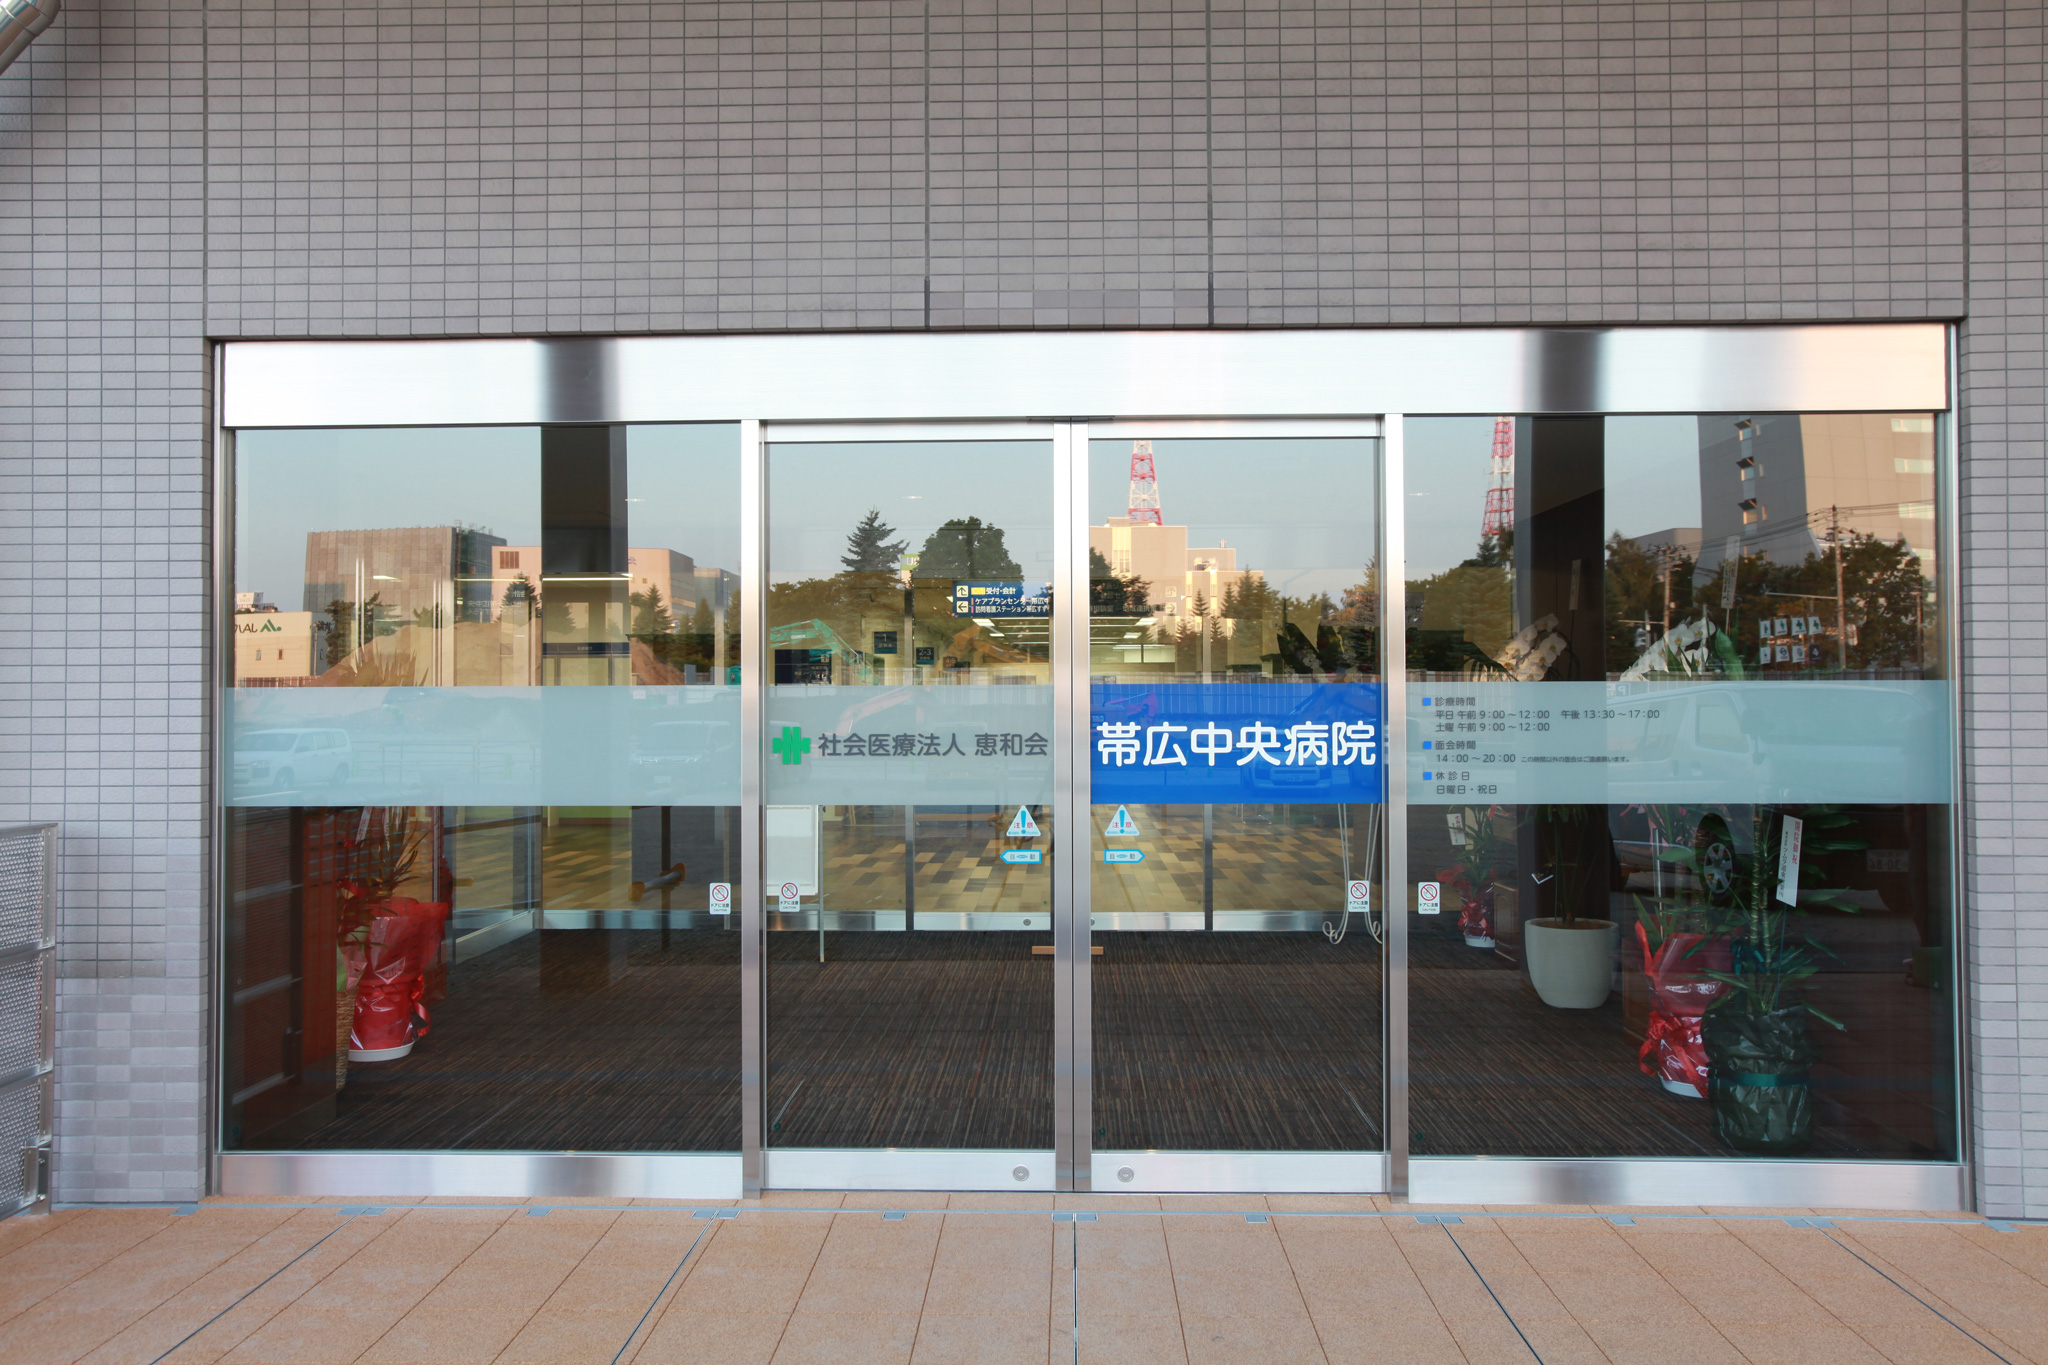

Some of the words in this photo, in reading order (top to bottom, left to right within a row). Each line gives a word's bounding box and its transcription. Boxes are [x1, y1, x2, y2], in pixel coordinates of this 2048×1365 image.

[1434, 696, 1476, 707] 診療時間
[1435, 710, 1454, 720] 平日
[1457, 710, 1477, 720] 午前
[1560, 710, 1580, 719] 午後
[1435, 722, 1454, 733] 土曜
[1457, 722, 1477, 732] 午前
[818, 732, 966, 757] 社会医療法人
[974, 732, 1049, 757] 恵和会
[1096, 720, 1377, 767] 帯広中央病院
[1435, 740, 1476, 750] 面会時間
